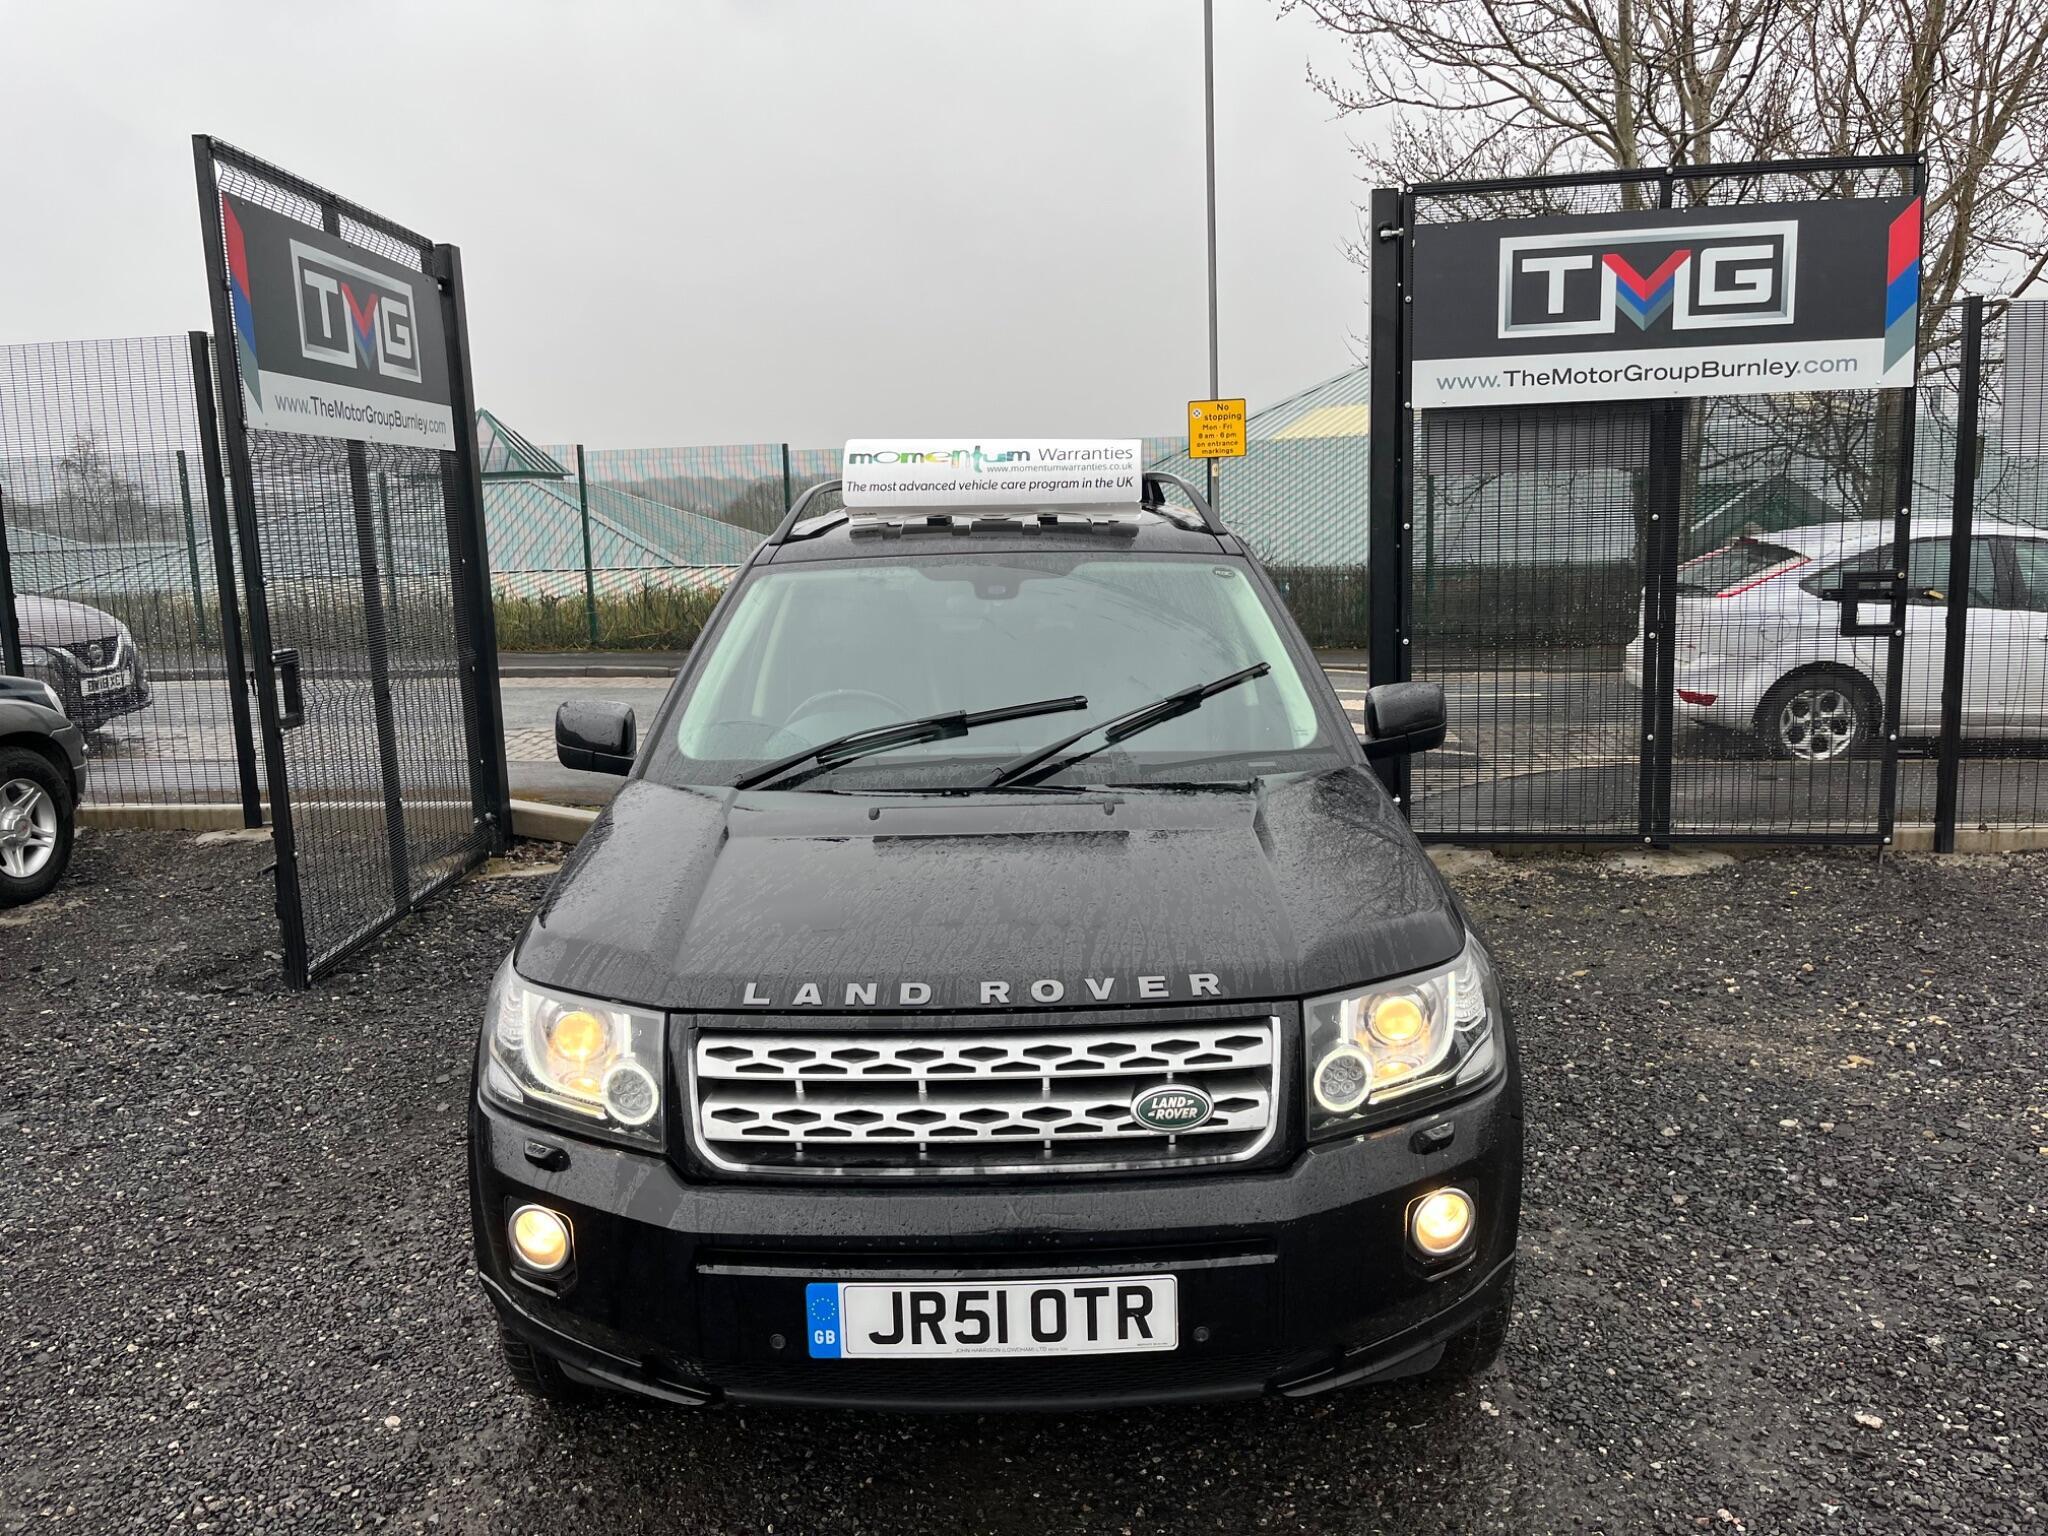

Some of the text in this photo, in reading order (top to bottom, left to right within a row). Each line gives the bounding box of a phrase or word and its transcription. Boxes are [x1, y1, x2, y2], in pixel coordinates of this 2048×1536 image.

[1522, 244, 1775, 331] TMG
[304, 268, 412, 374] TMG
[1436, 357, 1858, 391] www.TheMotorGroupBurnley.com
[274, 395, 447, 435] www.TheMotorGroupBurnley.com
[1204, 413, 1242, 421] stopping
[1216, 403, 1230, 411] No
[849, 445, 1134, 473] momentum Warranties
[986, 462, 1134, 473] www.momentumwarranties.co.uk
[847, 475, 1134, 492] The most advanced vehicle care program in the UK
[743, 973, 1221, 1006] LAND ROVER
[1151, 1096, 1187, 1109] LAND
[1155, 1107, 1198, 1120] ROVER
[868, 1285, 1154, 1345] JR51 OTR
[814, 1330, 836, 1345] GB
